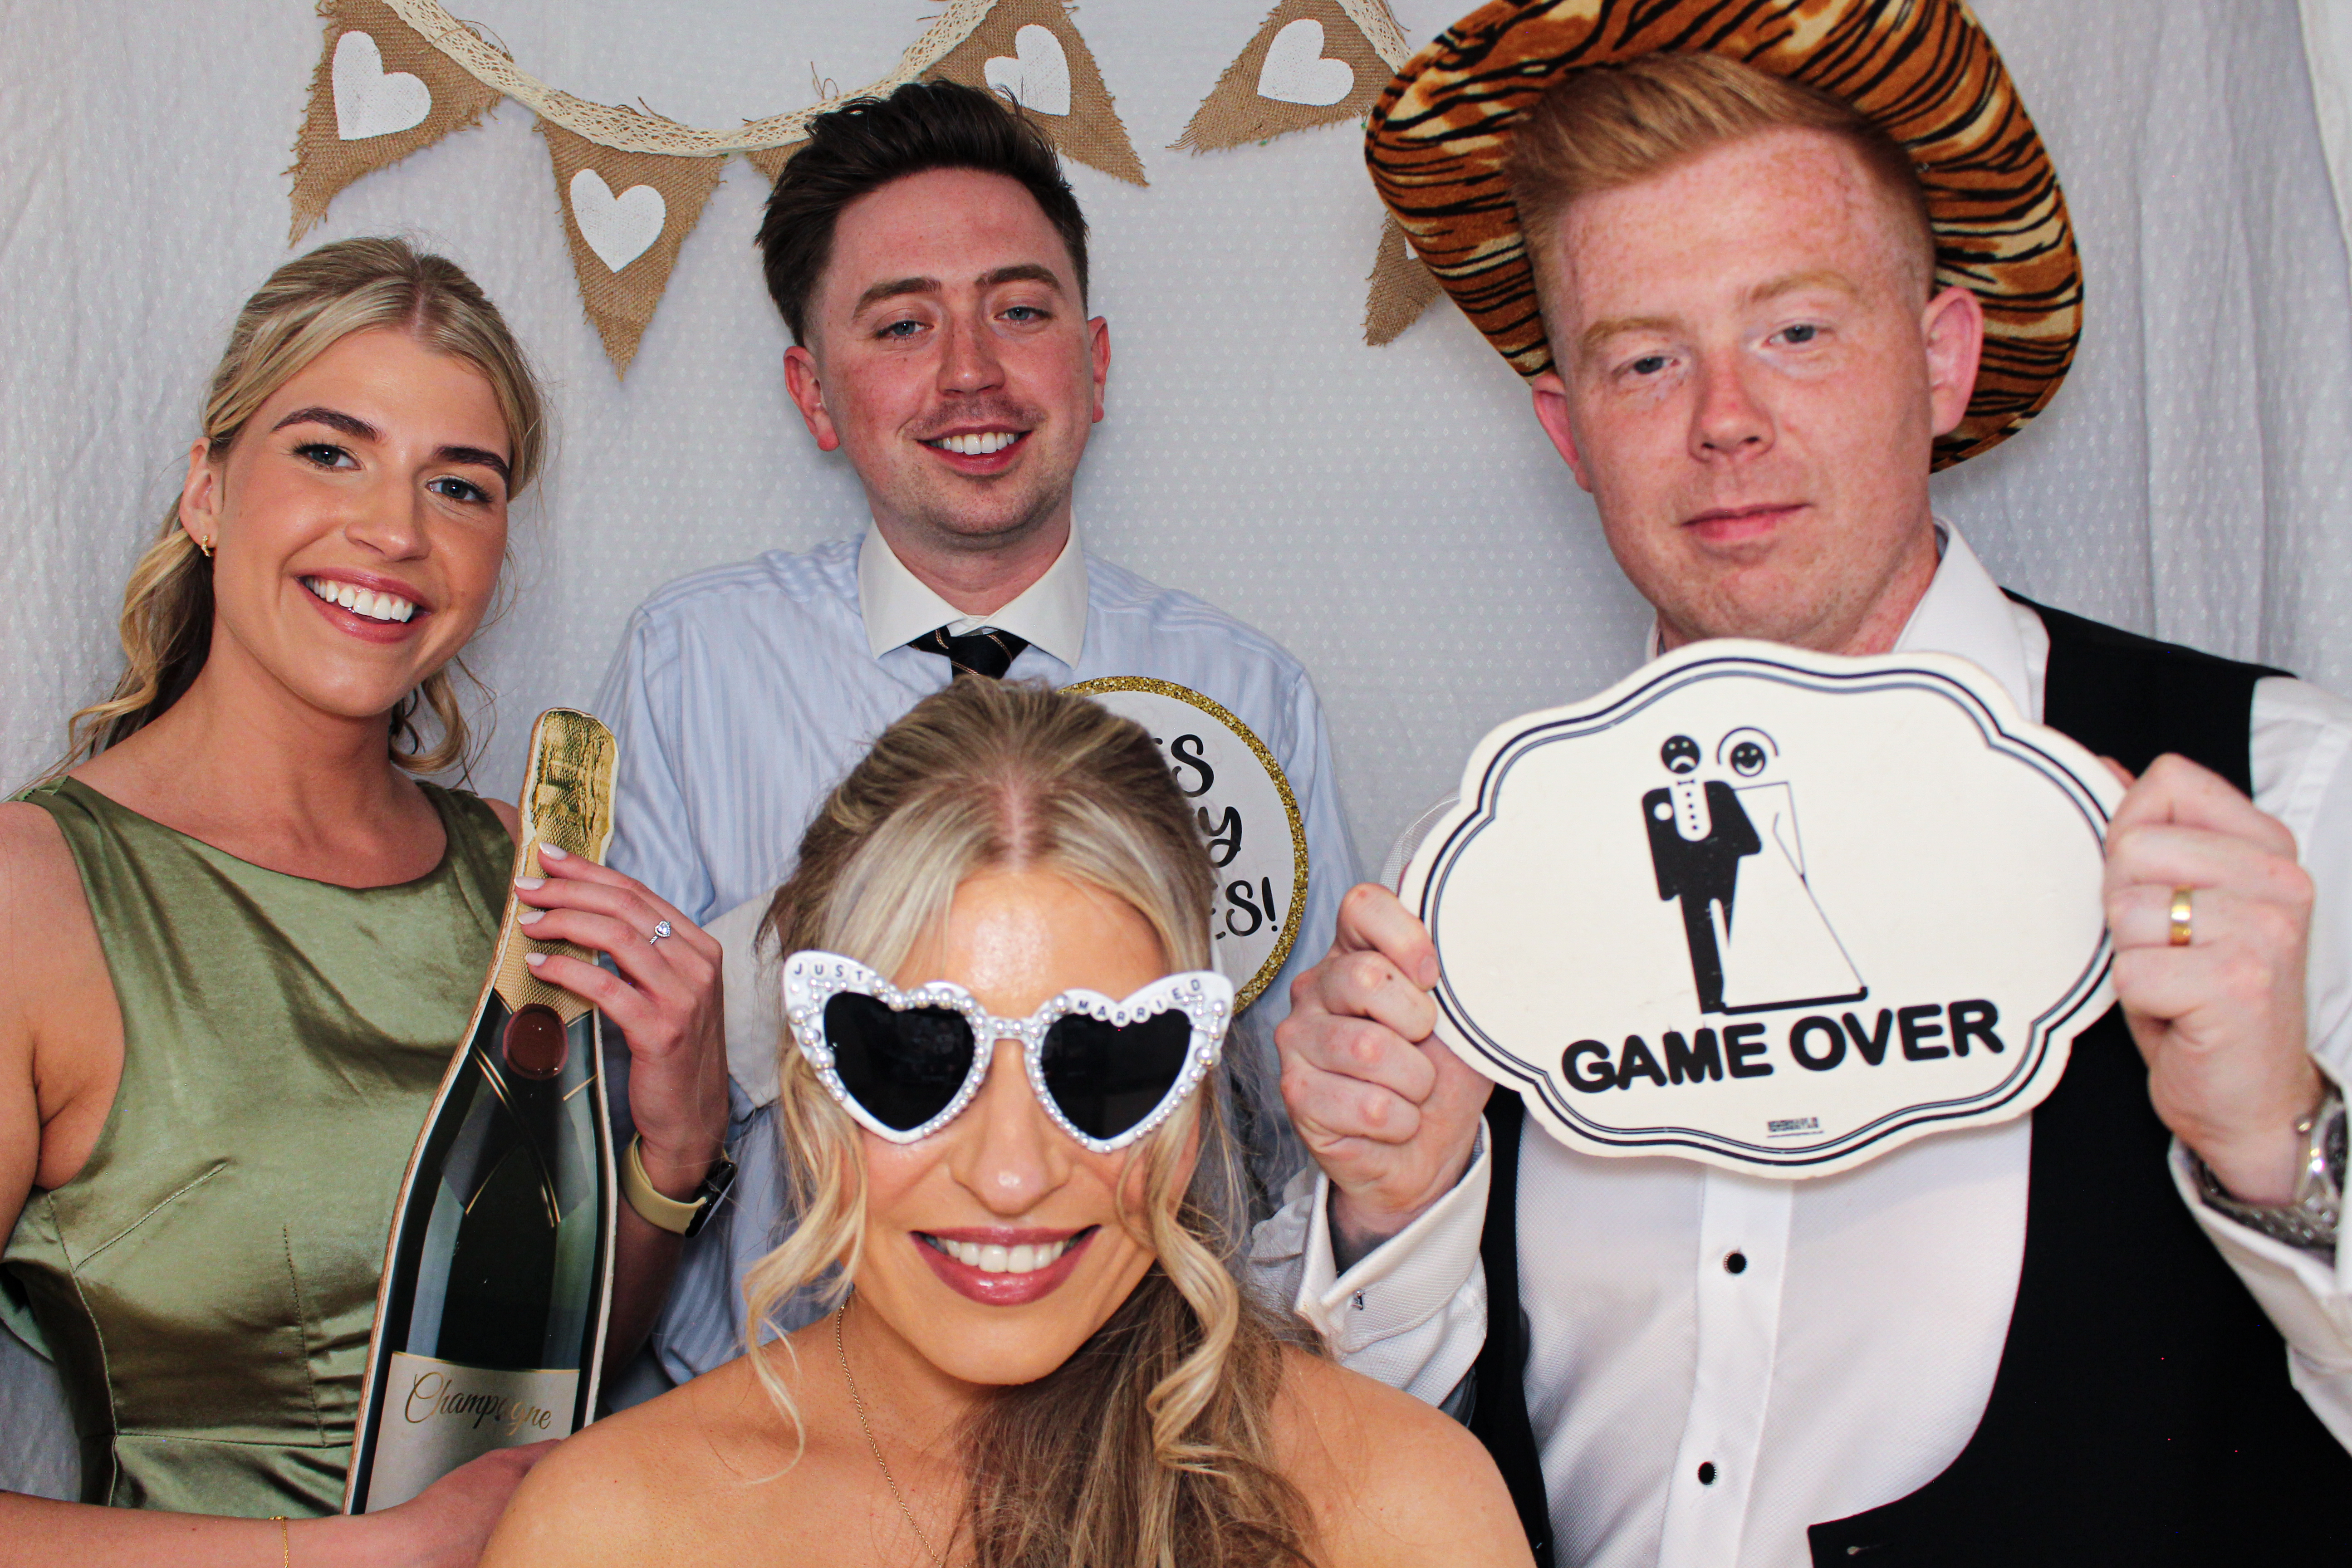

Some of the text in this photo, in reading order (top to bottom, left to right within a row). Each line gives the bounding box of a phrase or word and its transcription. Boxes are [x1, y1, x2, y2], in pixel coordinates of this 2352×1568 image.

[794, 963, 1200, 1021] JUST MARRIED
[1561, 999, 2005, 1094] GAME OVER
[405, 1372, 552, 1436] Champagne
